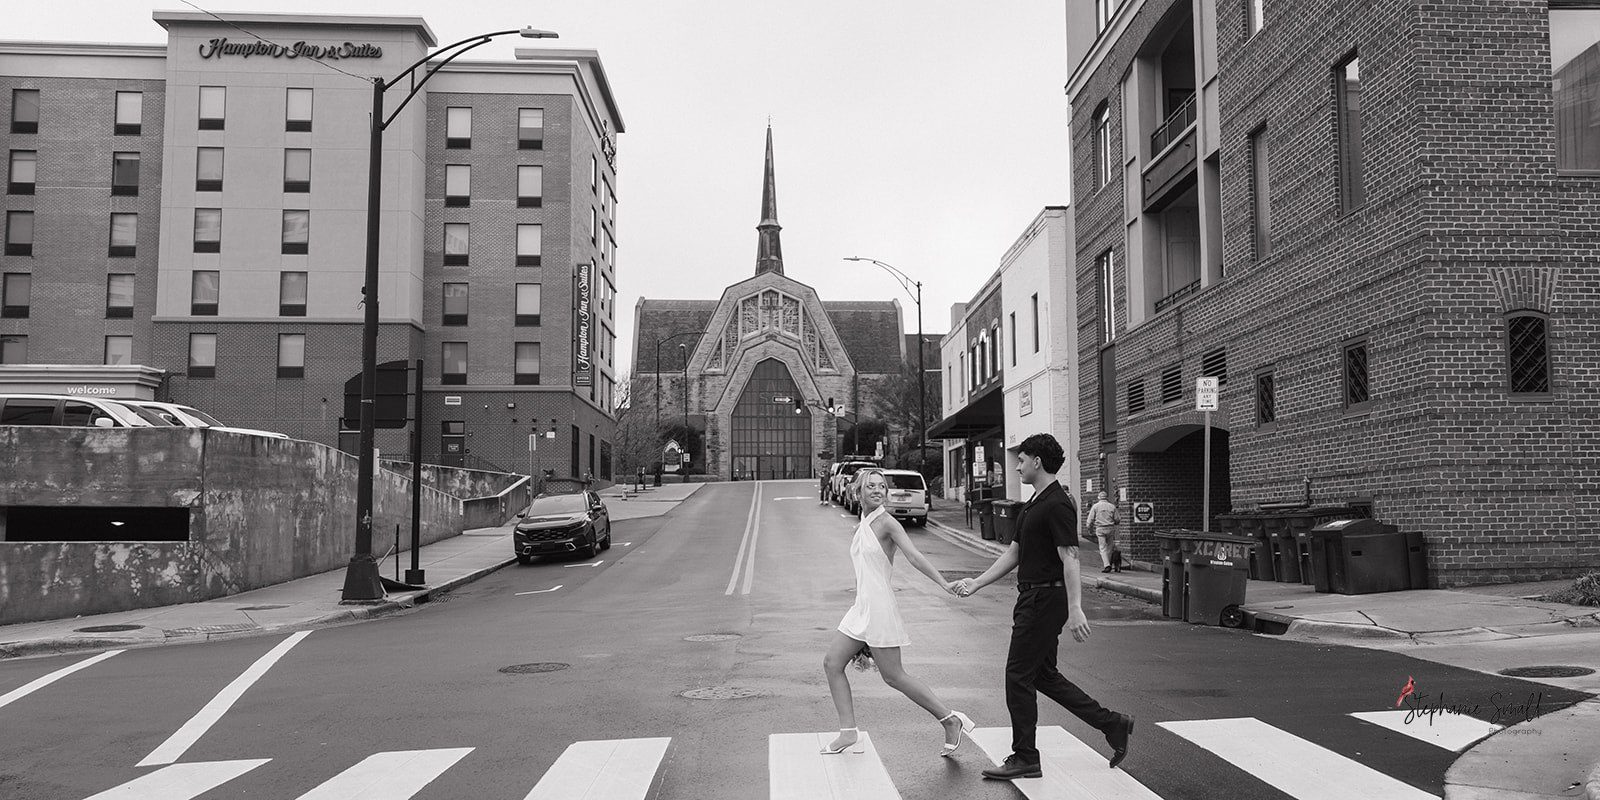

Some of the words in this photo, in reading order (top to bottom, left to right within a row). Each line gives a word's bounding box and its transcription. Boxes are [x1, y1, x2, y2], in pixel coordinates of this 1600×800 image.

[199, 38, 283, 59] Hampton
[284, 41, 326, 59] Inn
[326, 45, 339, 60] &
[337, 42, 382, 58] Suites
[577, 265, 589, 292] Suites
[577, 298, 590, 321] Inn
[577, 321, 590, 370] Hampton
[67, 385, 116, 394] welcome
